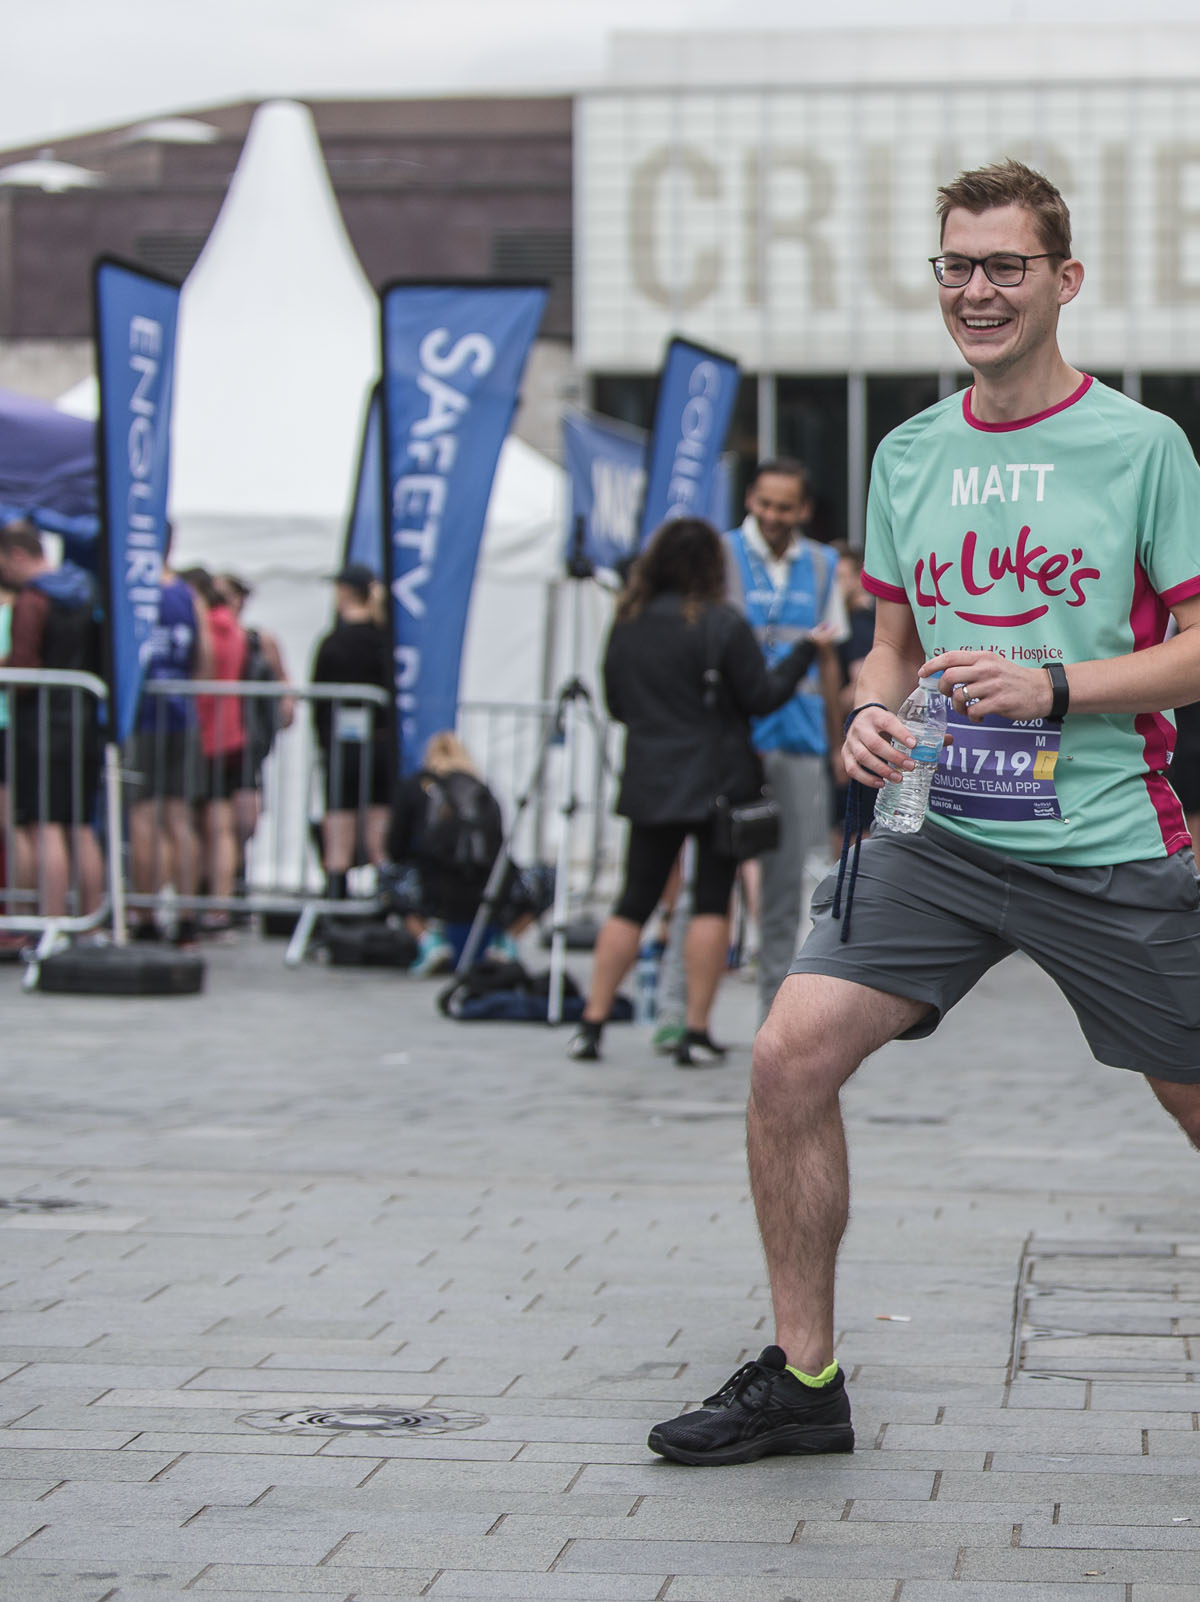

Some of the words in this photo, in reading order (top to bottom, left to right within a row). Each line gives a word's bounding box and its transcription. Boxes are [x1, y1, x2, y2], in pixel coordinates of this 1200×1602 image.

[391, 327, 495, 619] SAFETY
[951, 463, 1055, 506] MATT
[961, 525, 1101, 607] Luke's
[1011, 645, 1064, 663] Hospice
[1035, 736, 1046, 747] M
[946, 745, 1032, 776] 11719
[934, 774, 977, 790] SMUDGE
[980, 780, 1013, 793] TEAM
[1016, 782, 1041, 793] PPP
